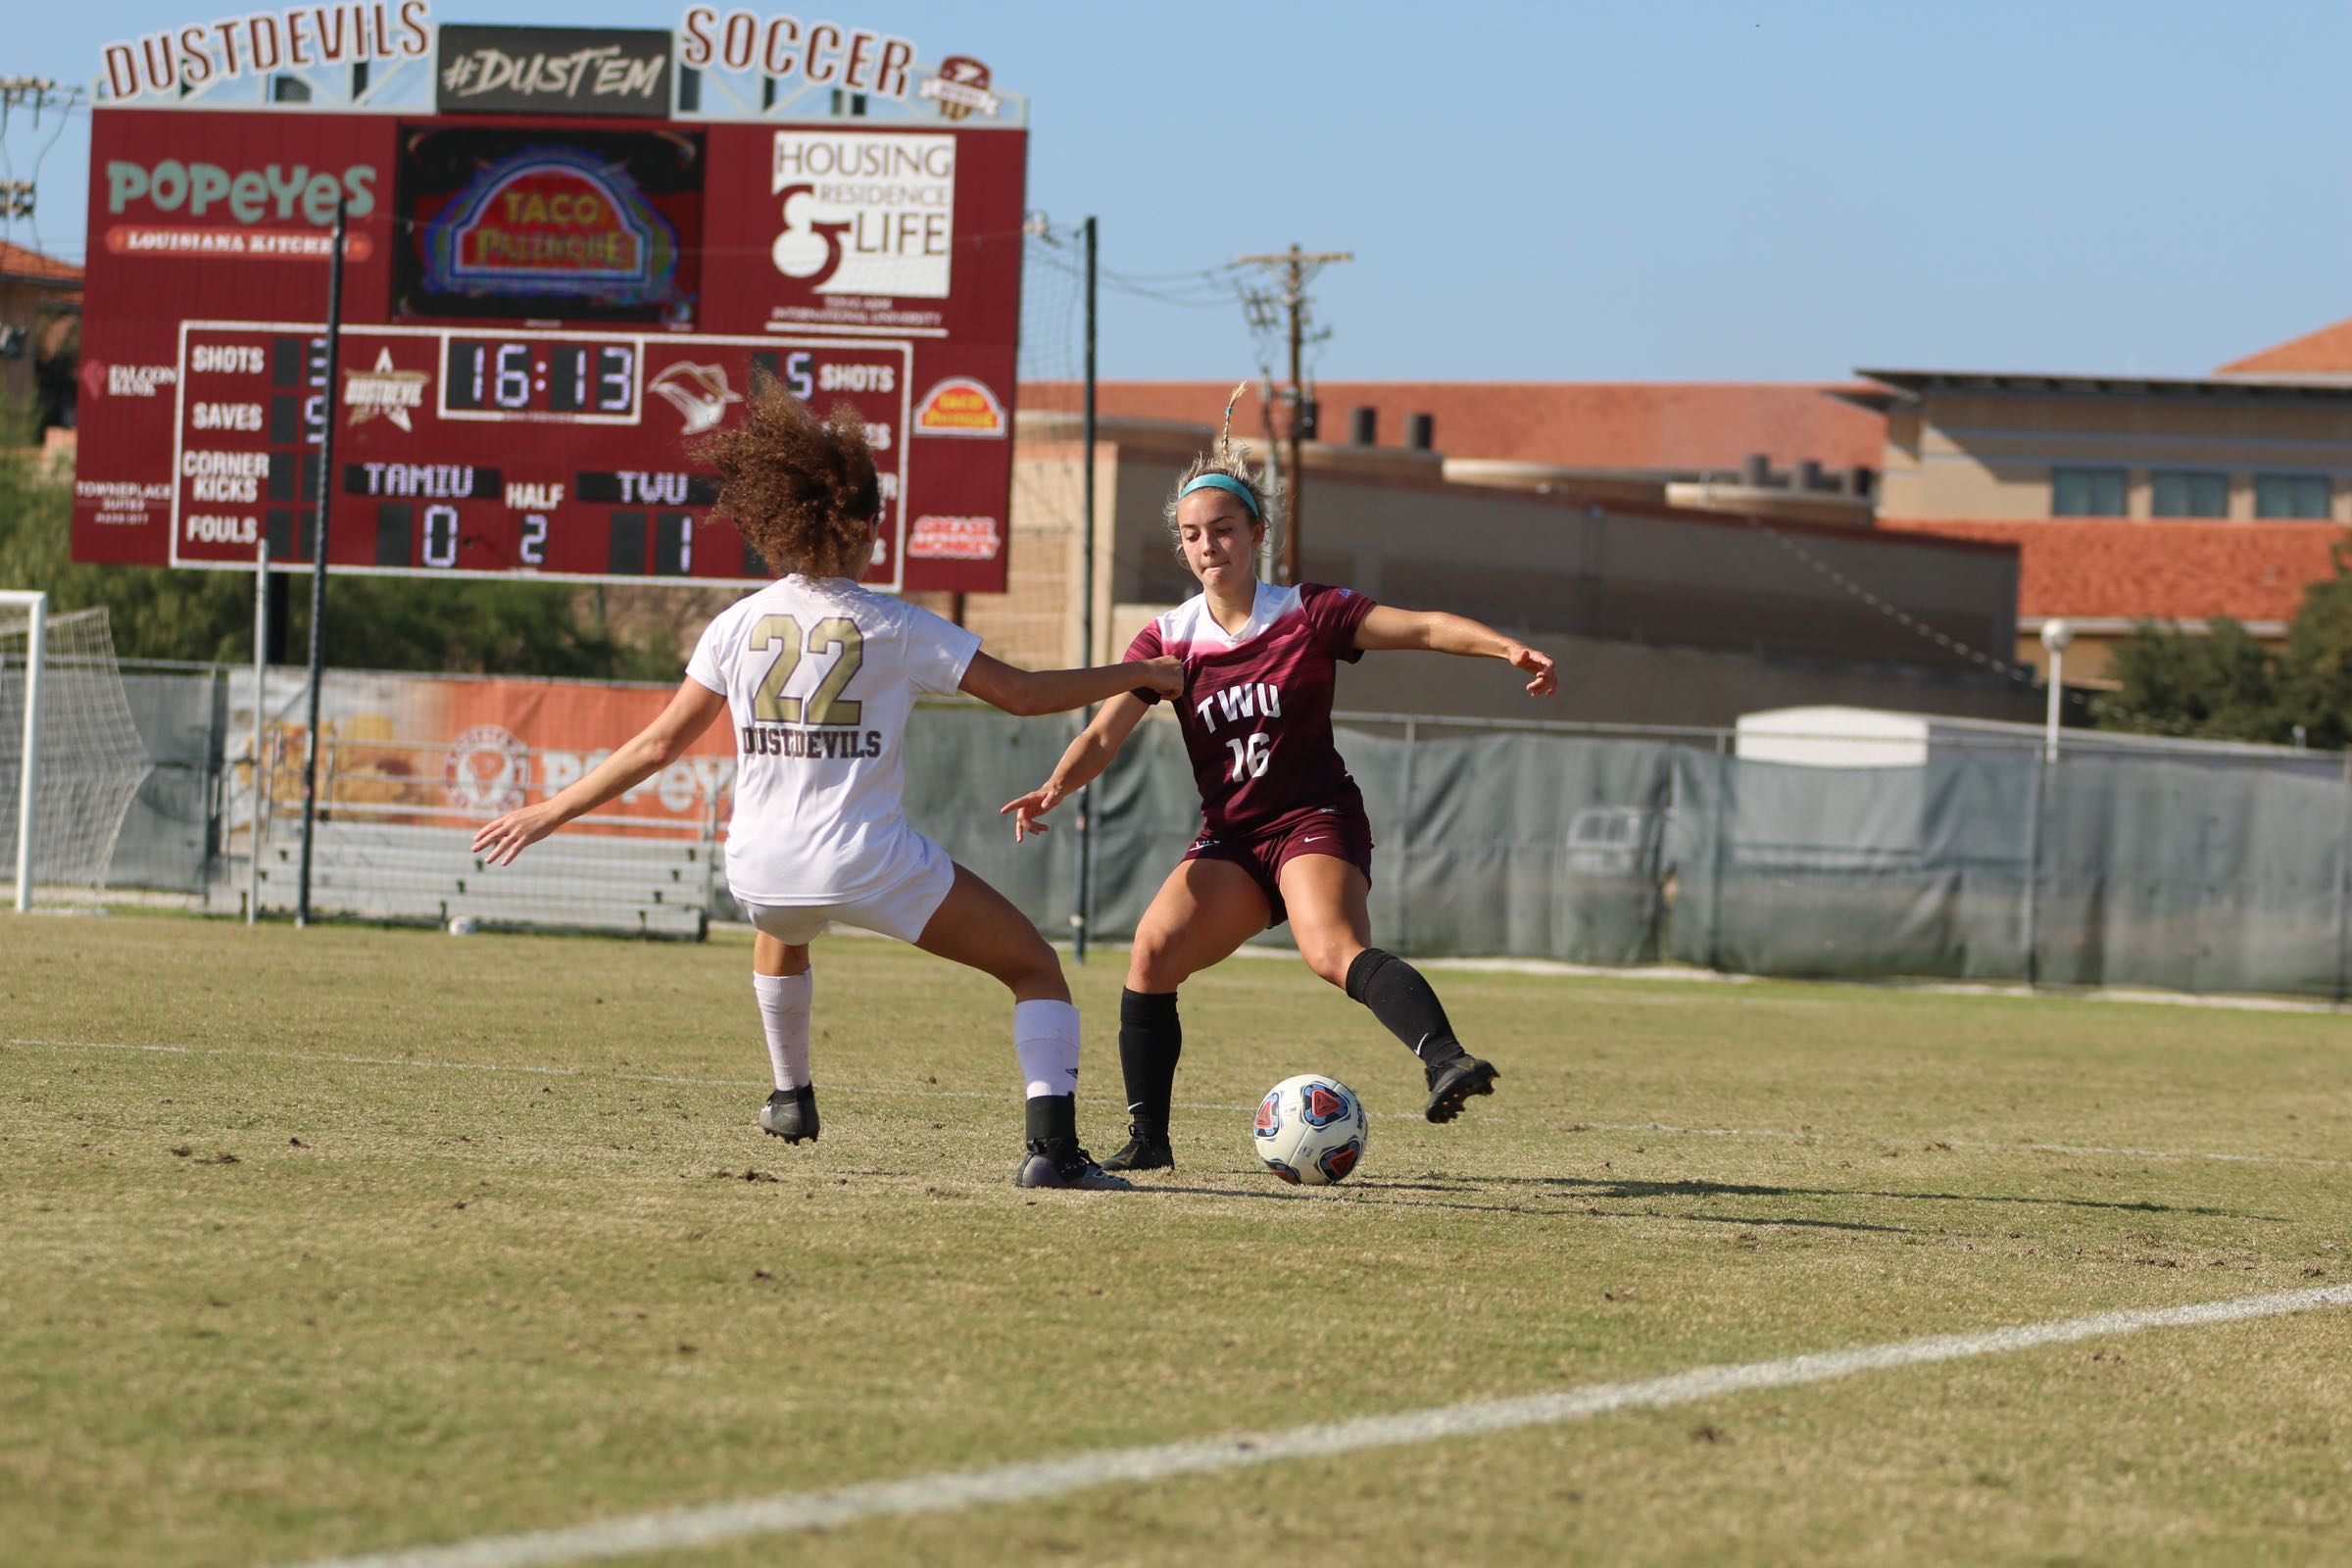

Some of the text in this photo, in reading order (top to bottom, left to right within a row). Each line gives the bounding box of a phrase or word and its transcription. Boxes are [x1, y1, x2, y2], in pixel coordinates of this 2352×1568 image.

[104, 0, 430, 99] DUSTDEVILS
[685, 8, 913, 97] SOCCER
[777, 142, 953, 177] HOUSING
[504, 192, 599, 224] TACO
[820, 183, 949, 207] RESIDENCE
[128, 231, 245, 253] LOUISIANA
[857, 212, 948, 255] LIFE
[191, 344, 265, 373] SHOTS
[786, 351, 813, 400] 5
[472, 344, 633, 410] 16:13
[818, 364, 895, 392] SHOTS
[192, 401, 263, 431] SAVES
[182, 450, 270, 478] CORNER
[364, 463, 474, 497] TAMIU
[192, 475, 258, 503] KICKS
[505, 482, 564, 511] HALF
[616, 471, 688, 505] TWU
[186, 514, 258, 544] FOULS
[422, 504, 458, 567] 0
[519, 514, 548, 564] 2
[680, 515, 692, 572] 1
[749, 613, 864, 726] 22
[1197, 682, 1282, 734] TWU
[742, 727, 882, 760] DUSTDEVILS
[1225, 732, 1270, 783] 16
